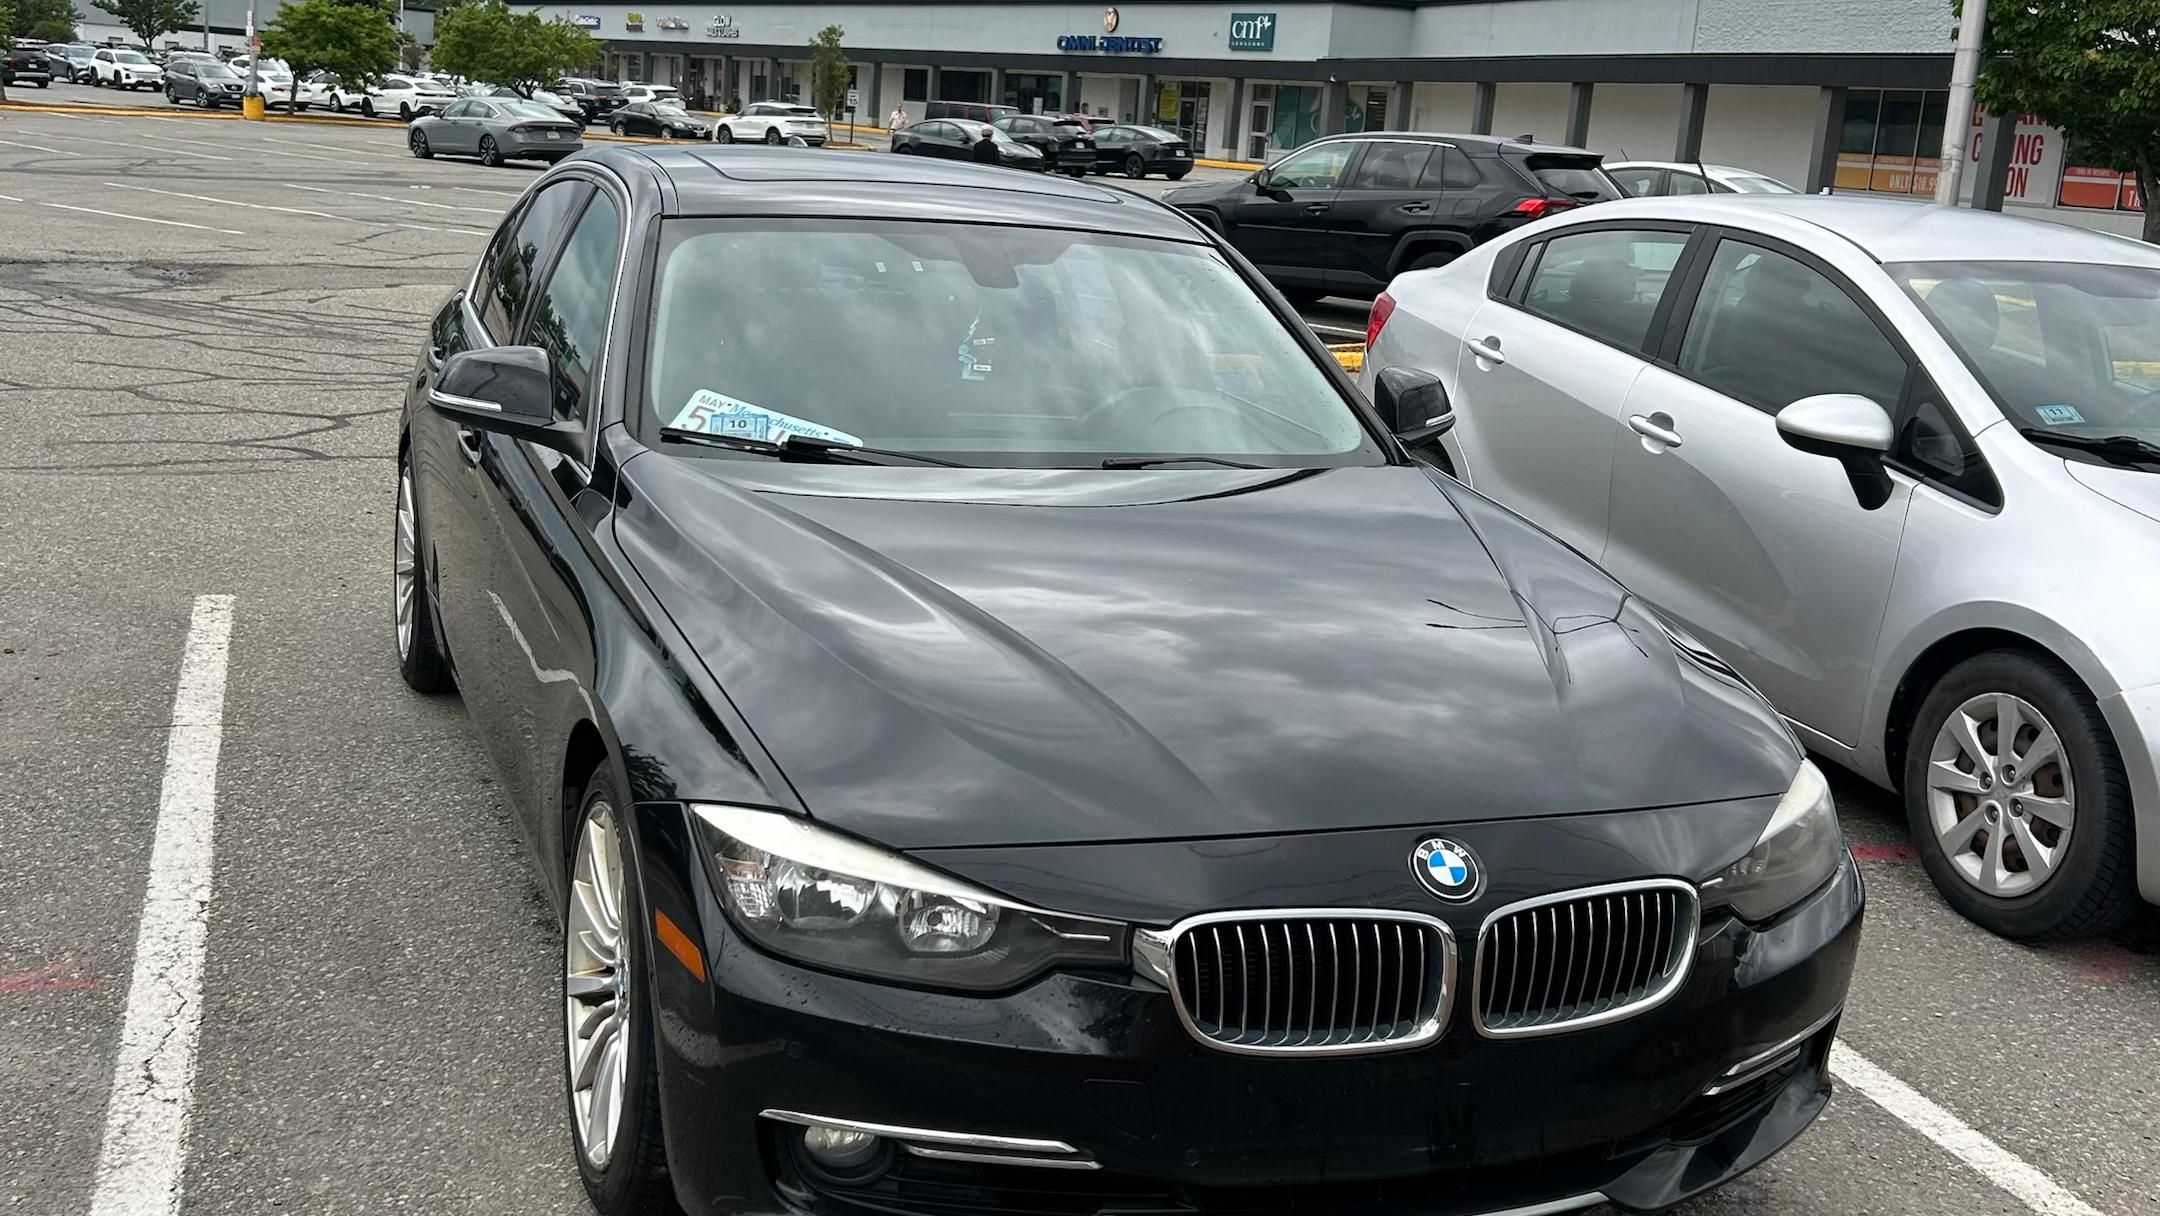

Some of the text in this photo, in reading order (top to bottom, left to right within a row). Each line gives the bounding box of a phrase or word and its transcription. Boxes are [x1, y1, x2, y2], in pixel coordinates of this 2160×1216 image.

[1232, 16, 1266, 39] cmf
[1057, 36, 1162, 52] OMNI DENTIST
[1889, 174, 1909, 189] ONLY
[699, 395, 727, 409] MAY
[729, 404, 823, 438] Machusetts
[729, 420, 747, 429] 10
[1417, 841, 1467, 861] BMW
